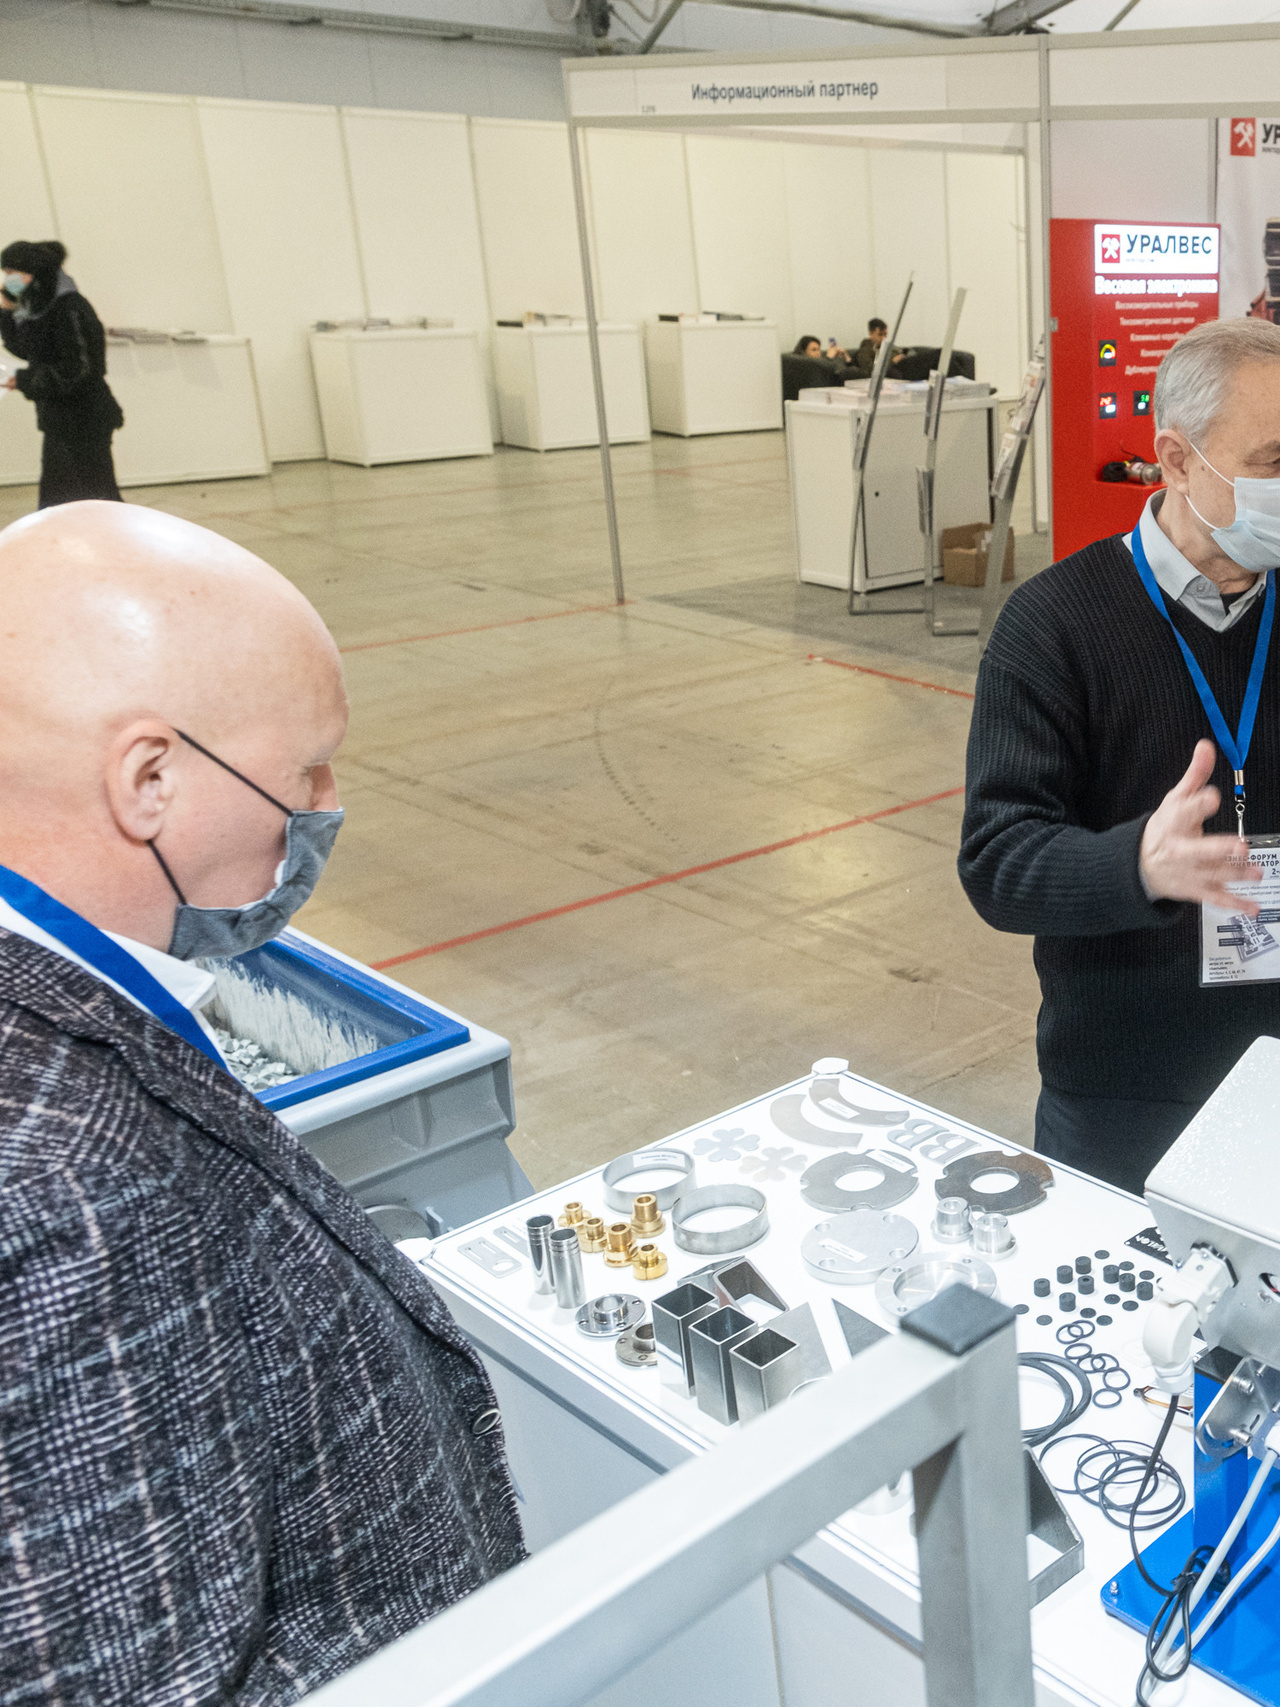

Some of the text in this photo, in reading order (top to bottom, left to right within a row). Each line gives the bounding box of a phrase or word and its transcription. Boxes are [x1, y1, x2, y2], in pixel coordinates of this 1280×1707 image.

[691, 80, 879, 104] Информационный партнер
[1126, 233, 1213, 255] УРАЛВЕС
